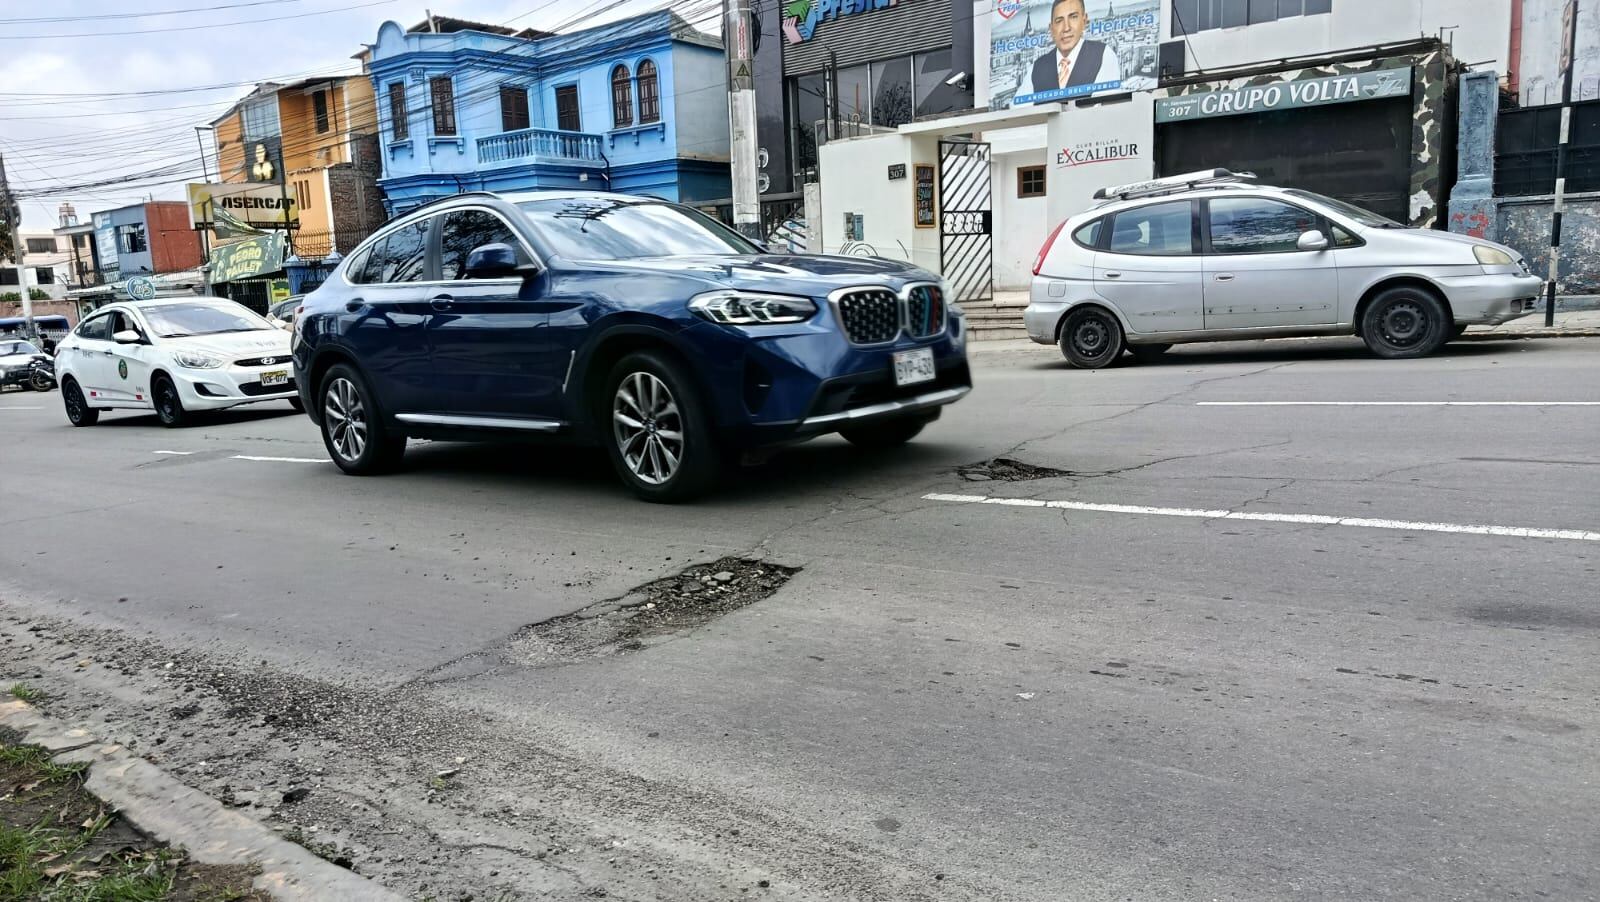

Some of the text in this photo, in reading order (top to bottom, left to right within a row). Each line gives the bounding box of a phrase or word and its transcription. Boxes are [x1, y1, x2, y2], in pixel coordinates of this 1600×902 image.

[1090, 14, 1154, 34] Herrera
[1201, 77, 1360, 114] GRUPO VOLTA
[1168, 106, 1191, 117] 307
[1057, 144, 1138, 165] EXCALIBUR
[890, 170, 904, 178] 307
[229, 247, 262, 266] PEDRO
[226, 261, 262, 281] PAULET
